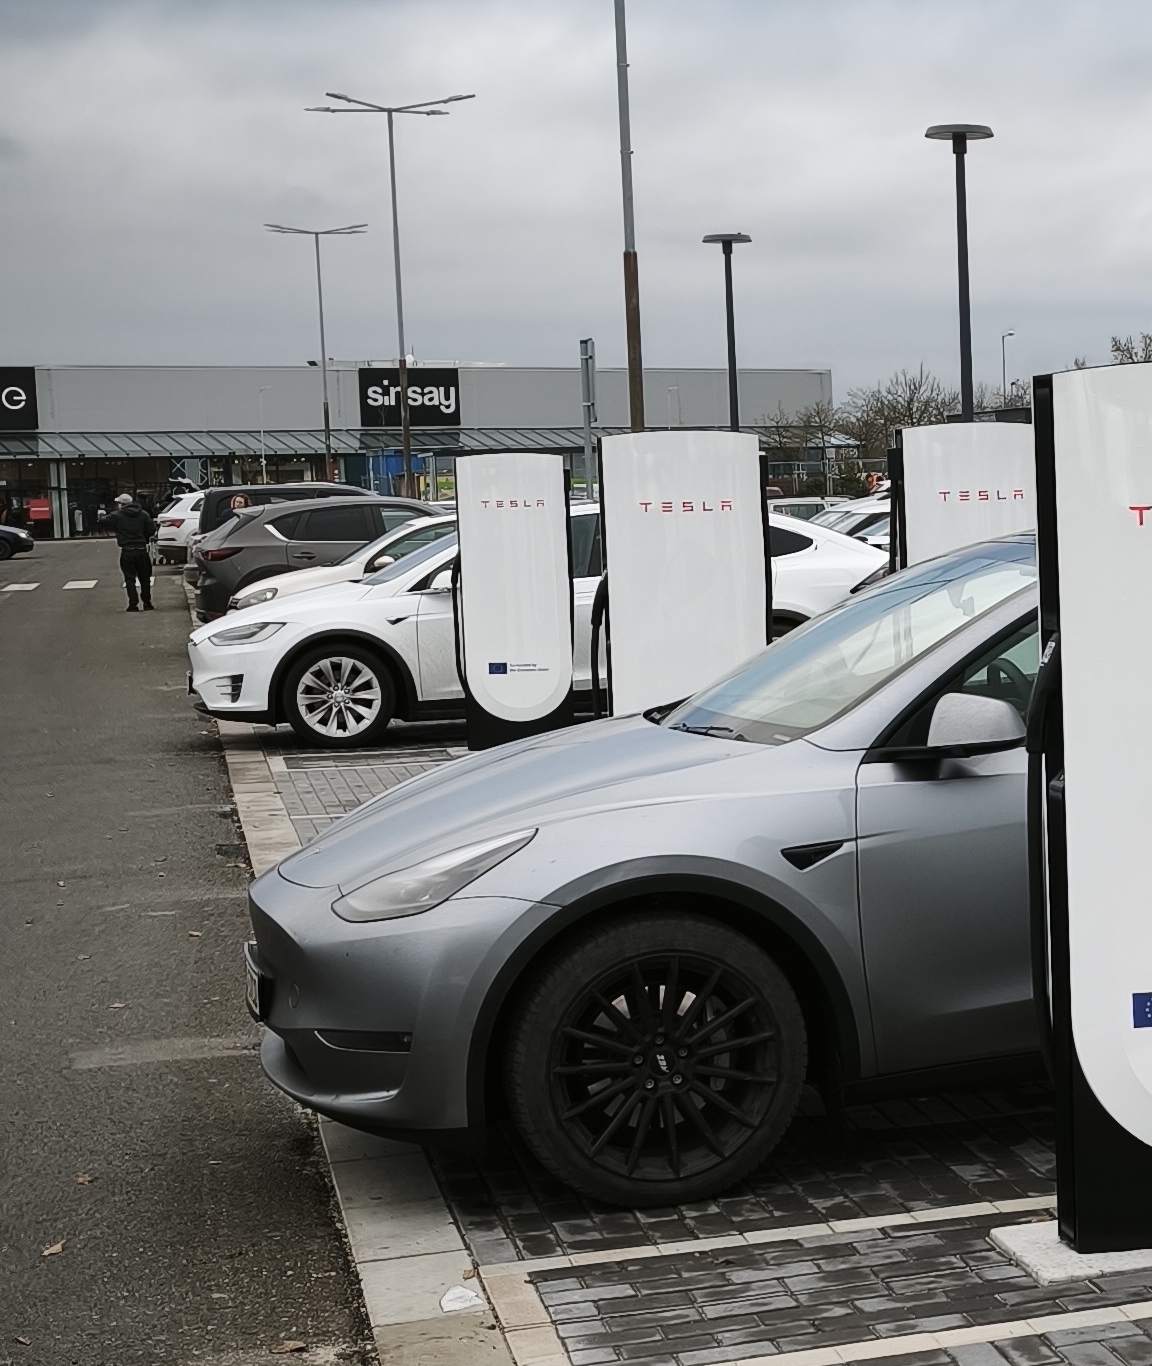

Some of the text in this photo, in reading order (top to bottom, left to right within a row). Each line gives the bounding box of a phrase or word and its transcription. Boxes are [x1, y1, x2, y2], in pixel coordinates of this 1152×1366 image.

[366, 379, 456, 414] sinsay
[938, 489, 1024, 503] TESLA
[480, 499, 545, 509] TESLA
[639, 500, 733, 513] TESLA
